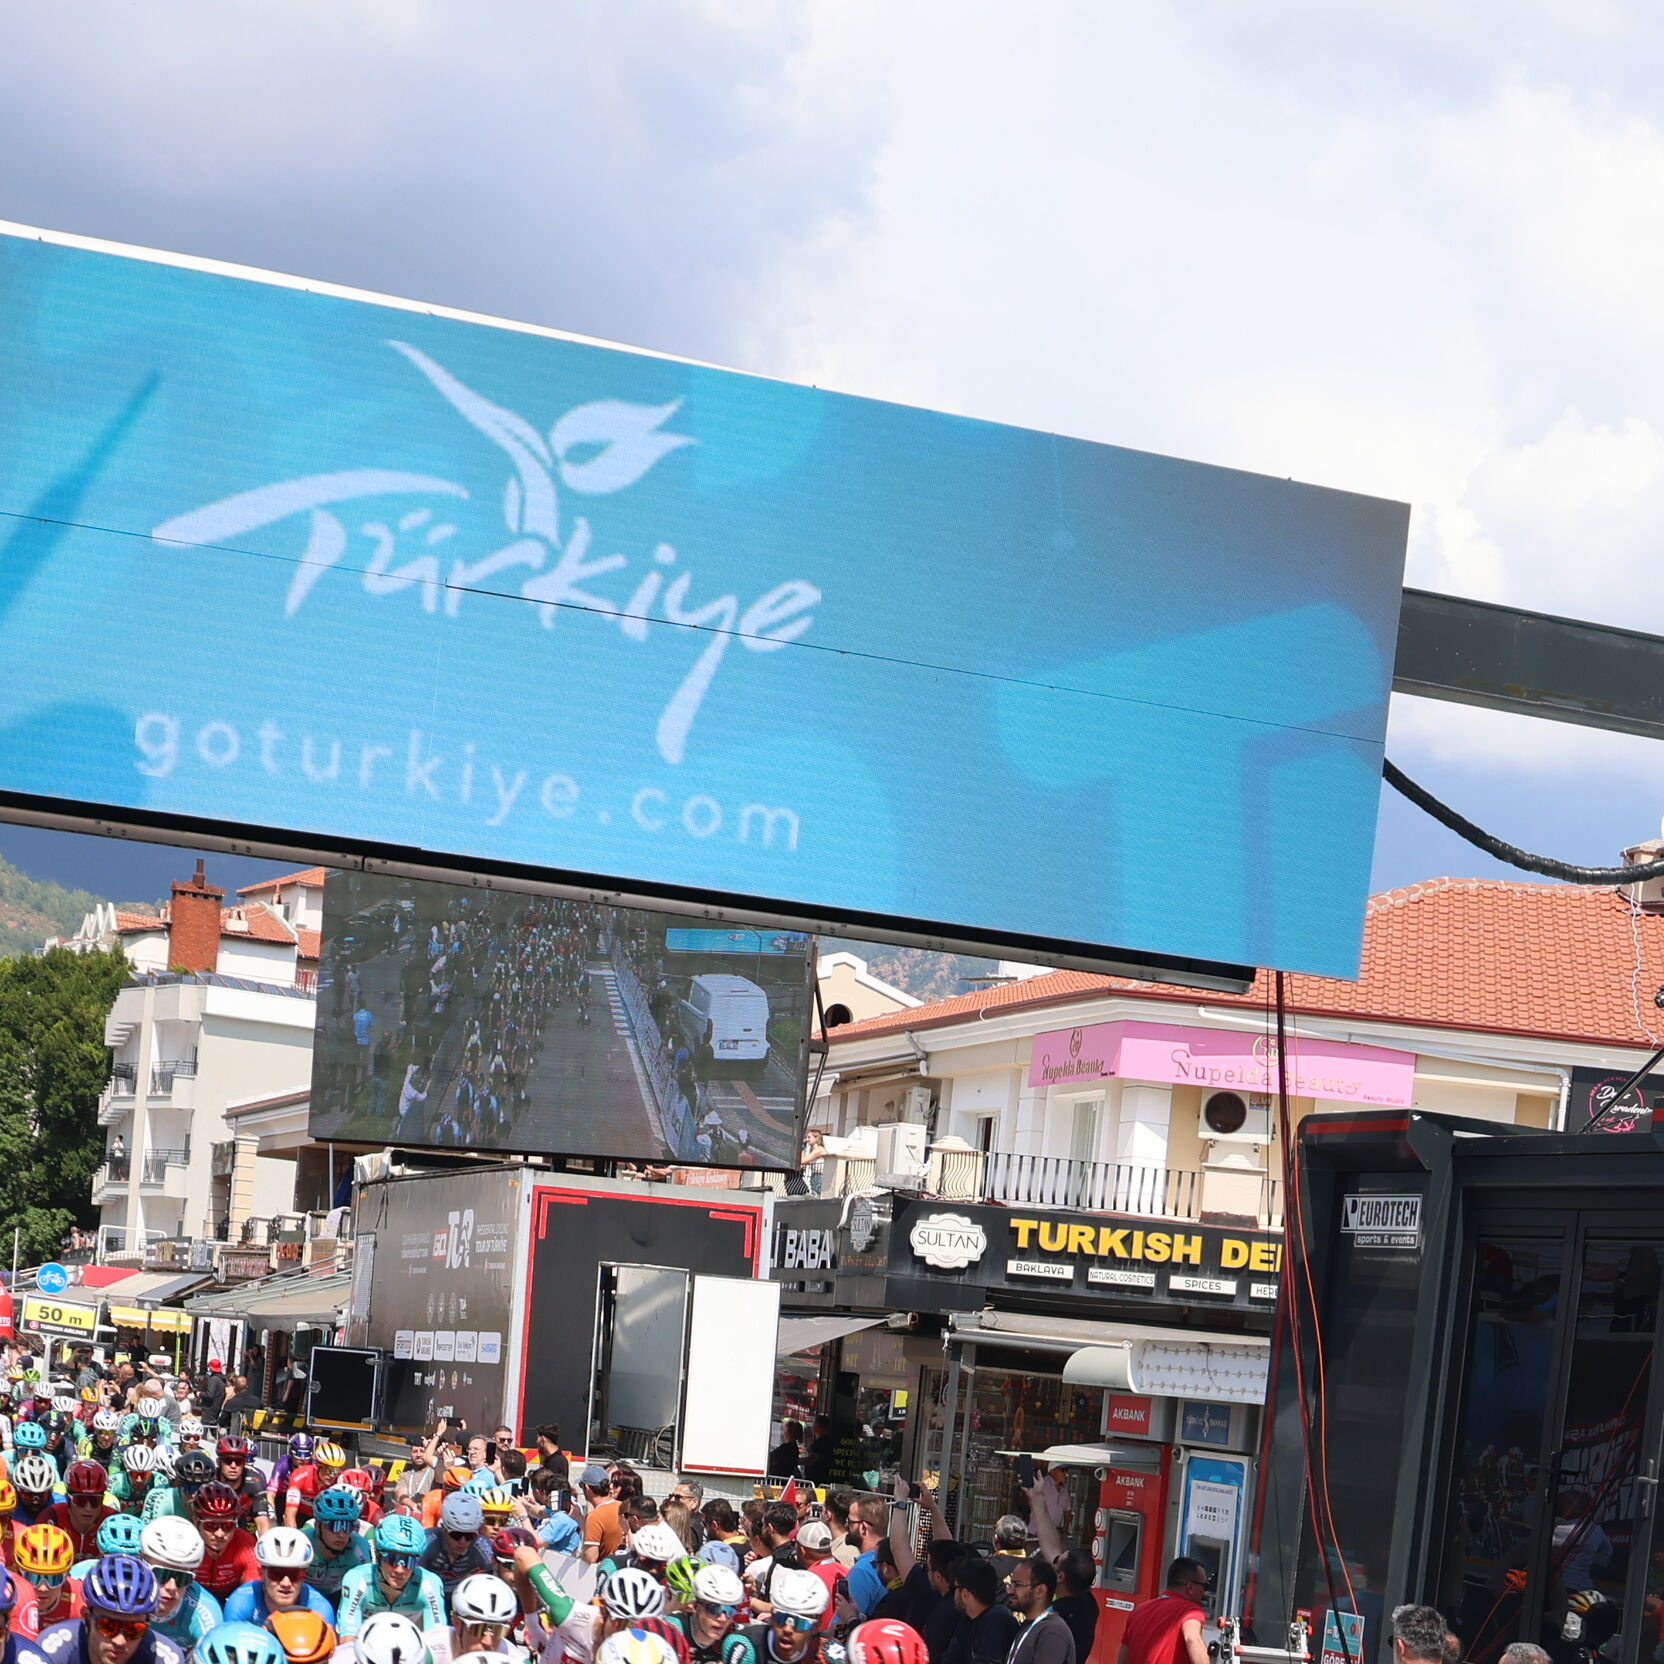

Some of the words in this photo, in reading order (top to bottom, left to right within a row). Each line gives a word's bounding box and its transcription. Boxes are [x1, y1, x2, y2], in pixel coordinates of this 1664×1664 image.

[150, 468, 822, 764] Türkiye
[132, 711, 801, 852] goturkiye.com
[1041, 1052, 1075, 1082] Nupelda
[1170, 1048, 1273, 1088] Nupelda
[1358, 1199, 1420, 1227] EUROTECH
[851, 1217, 871, 1234] SULTAN
[786, 1229, 833, 1269] BABA
[916, 1230, 979, 1250] SULTAN
[1009, 1217, 1204, 1266] TURKISH
[1356, 1233, 1383, 1248] sports
[1390, 1235, 1416, 1246] events
[1014, 1261, 1066, 1277] BAKLAVA
[1089, 1270, 1120, 1283] NATURAL
[1120, 1272, 1155, 1287] COSMETICS
[1183, 1278, 1223, 1292] SPICES
[38, 1305, 63, 1322] 50
[68, 1315, 83, 1326] m
[39, 1322, 62, 1332] TURKISH
[62, 1326, 88, 1336] AIRLINES
[1112, 1407, 1146, 1422] AKBANK
[1115, 1475, 1145, 1488] AKBANK
